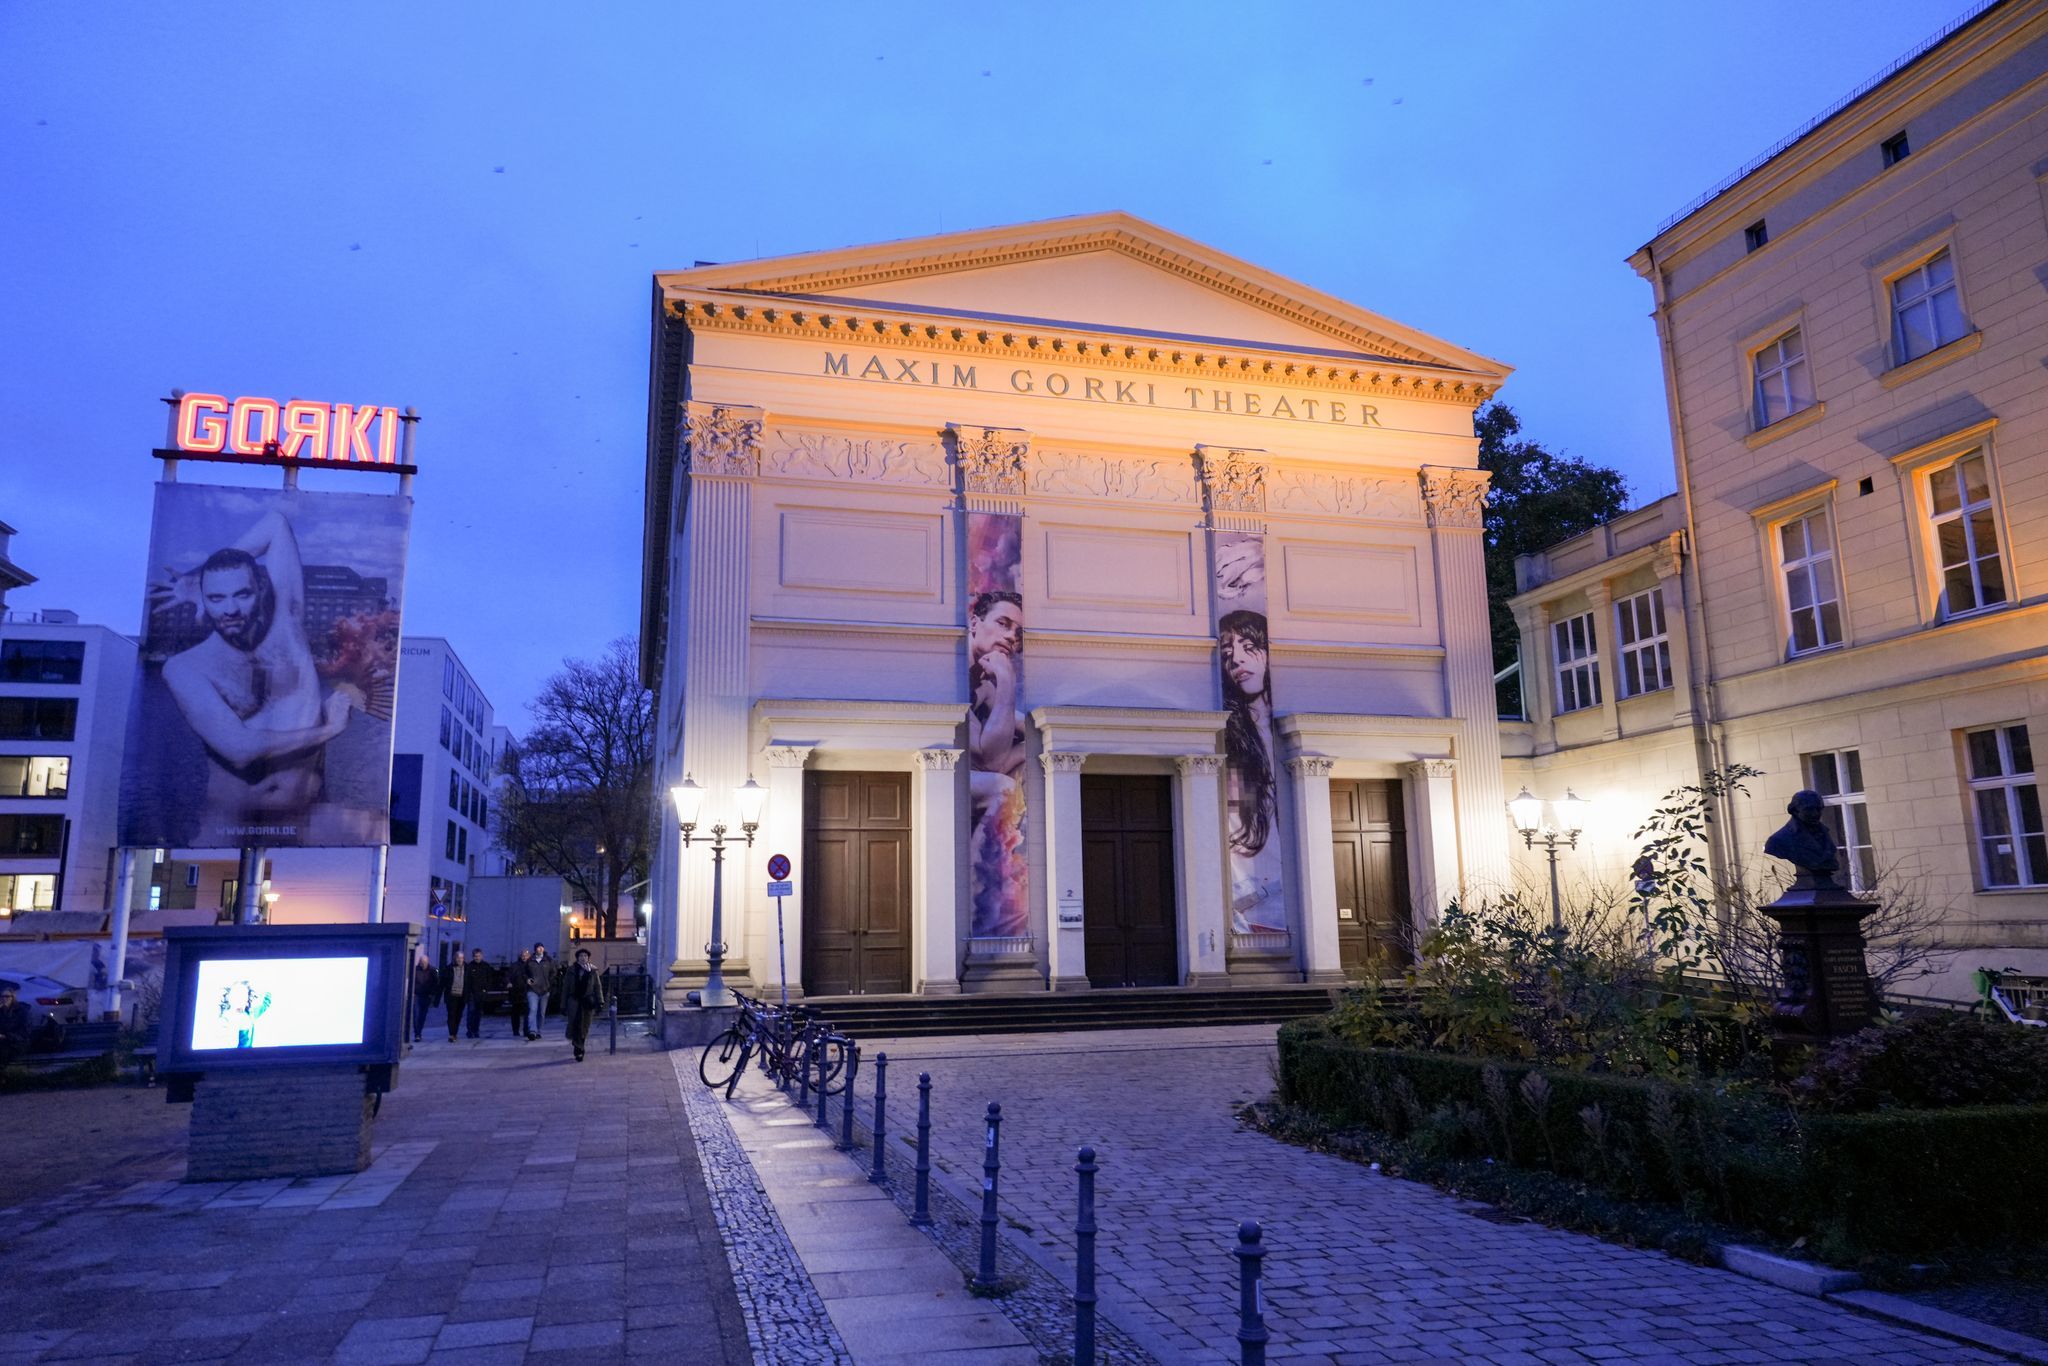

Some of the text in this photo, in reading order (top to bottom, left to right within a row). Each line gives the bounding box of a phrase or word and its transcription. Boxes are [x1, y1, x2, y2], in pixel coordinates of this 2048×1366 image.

[823, 351, 1382, 427] MAXIM GORKI THEATER
[401, 647, 431, 656] RICUM
[1066, 889, 1073, 898] 2
